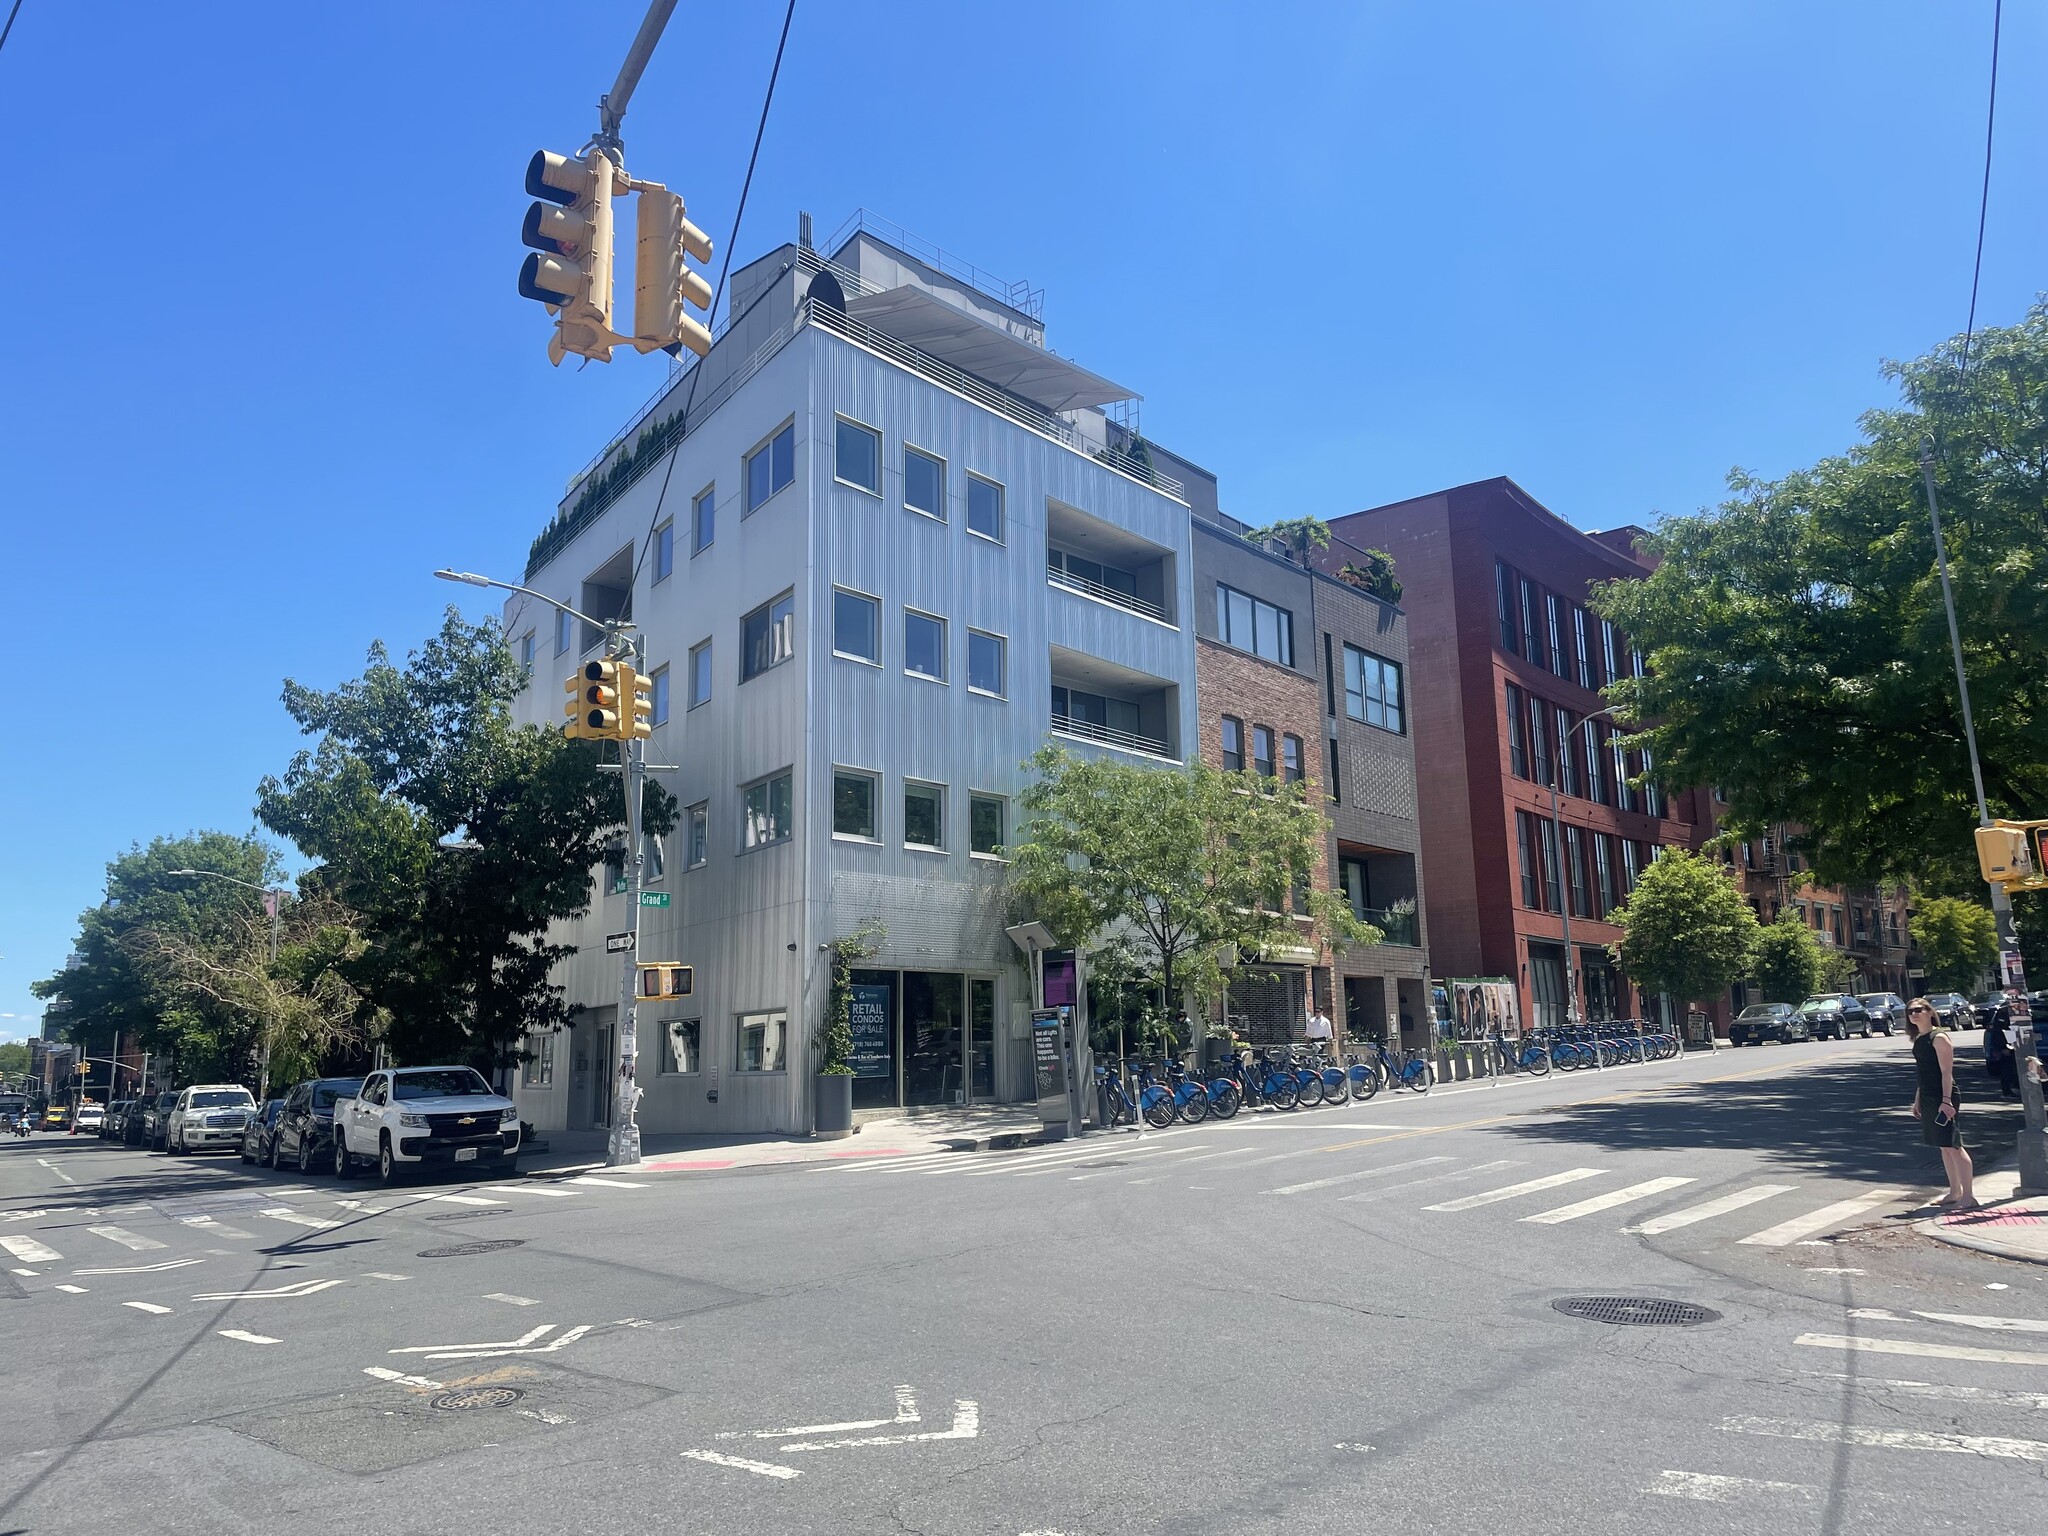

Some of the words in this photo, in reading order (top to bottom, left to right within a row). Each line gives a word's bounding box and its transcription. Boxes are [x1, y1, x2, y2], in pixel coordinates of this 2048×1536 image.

[642, 893, 660, 905] Grand
[610, 940, 620, 948] ONE
[623, 938, 632, 946] WAY
[852, 1003, 884, 1015] RETAIL
[852, 1015, 884, 1024] CONDOS
[852, 1025, 866, 1033] FOR
[867, 1025, 884, 1033] SALE
